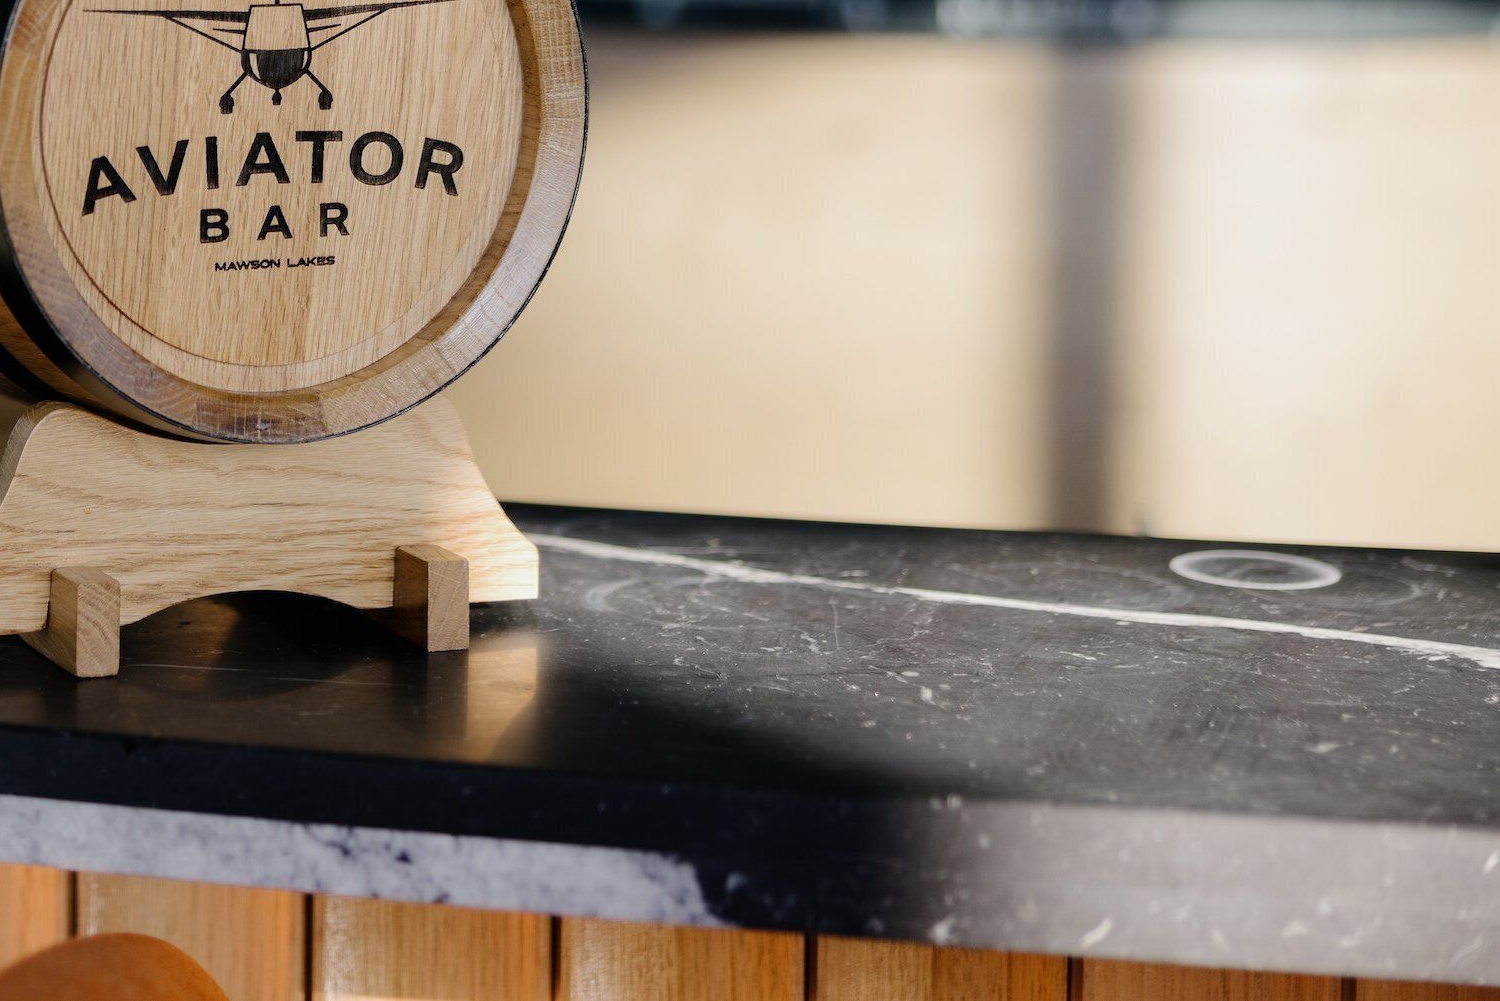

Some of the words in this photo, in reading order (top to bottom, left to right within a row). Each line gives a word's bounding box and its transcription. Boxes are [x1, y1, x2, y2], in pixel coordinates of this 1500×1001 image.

[81, 130, 465, 216] AVIATOR
[199, 202, 350, 244] BAR
[214, 258, 281, 272] MAWSON
[287, 255, 336, 267] LAKES
